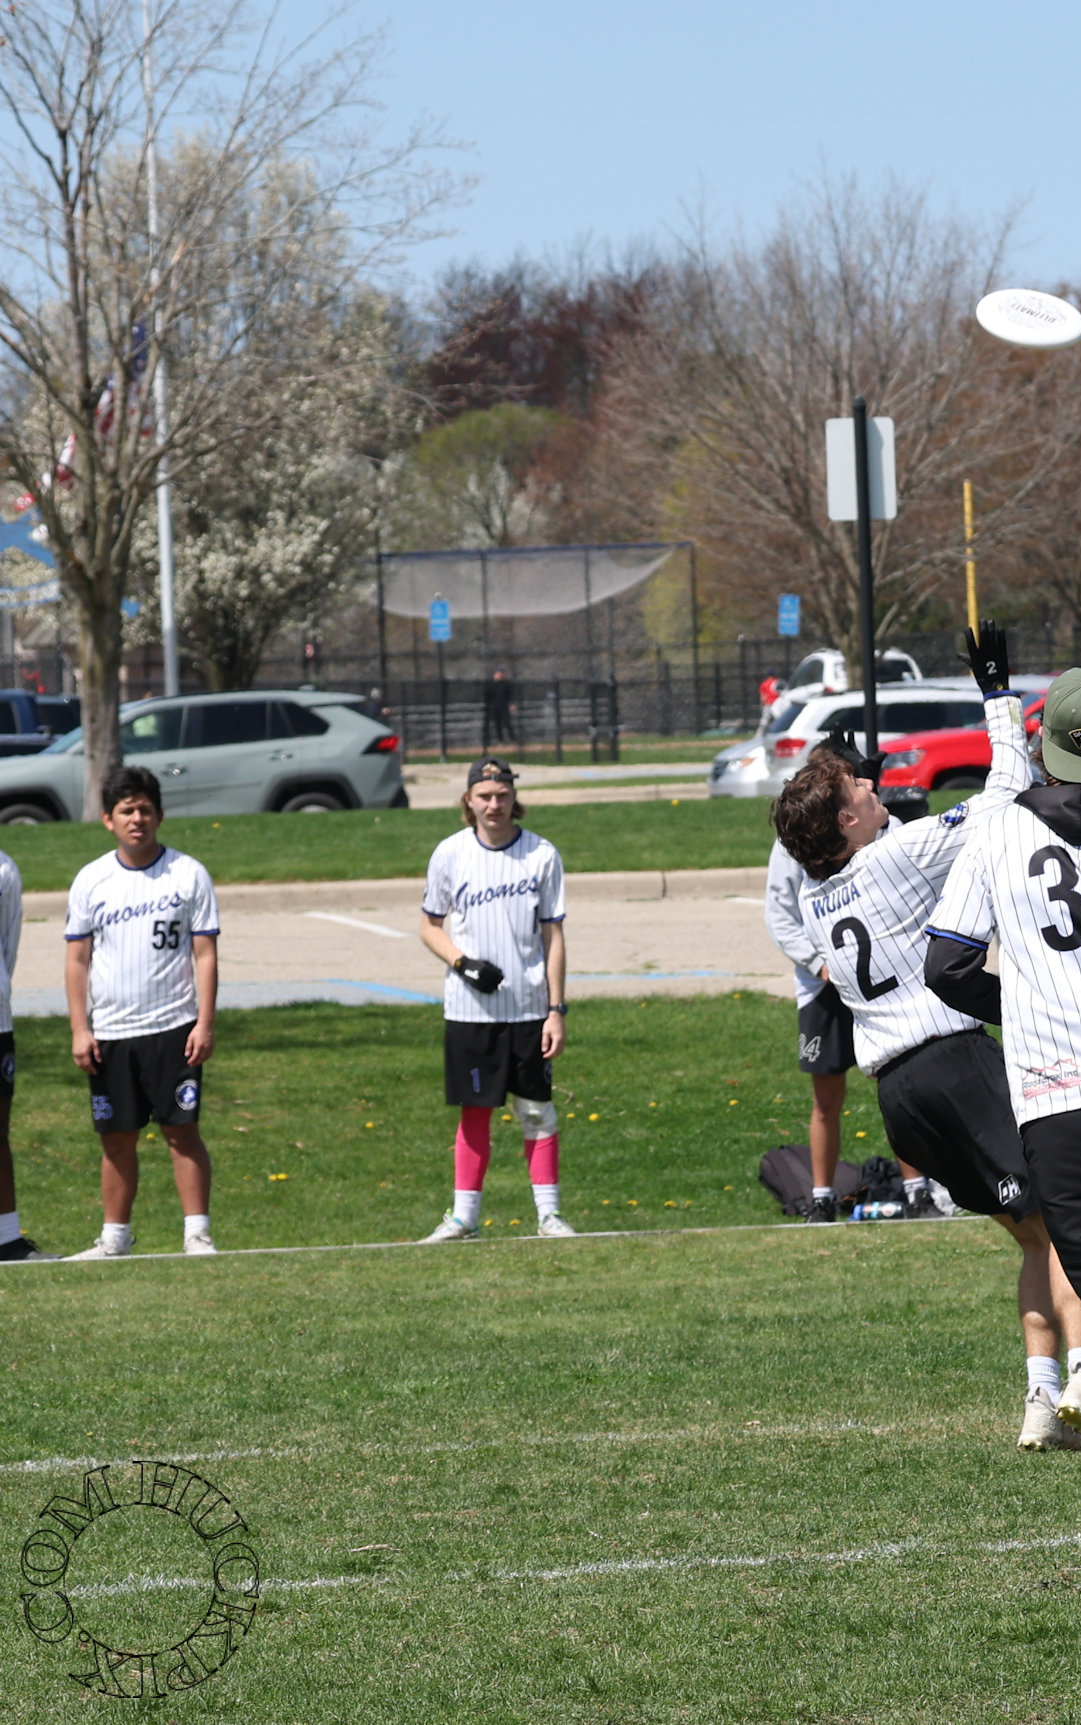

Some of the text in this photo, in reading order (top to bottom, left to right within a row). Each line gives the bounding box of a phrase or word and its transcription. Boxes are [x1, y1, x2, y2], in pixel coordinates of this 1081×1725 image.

[986, 660, 998, 675] 2
[92, 890, 182, 943] Gnomes
[456, 876, 539, 923] Gnomes
[152, 920, 181, 950] 55
[831, 916, 899, 1002] 2
[469, 1067, 480, 1093] 1
